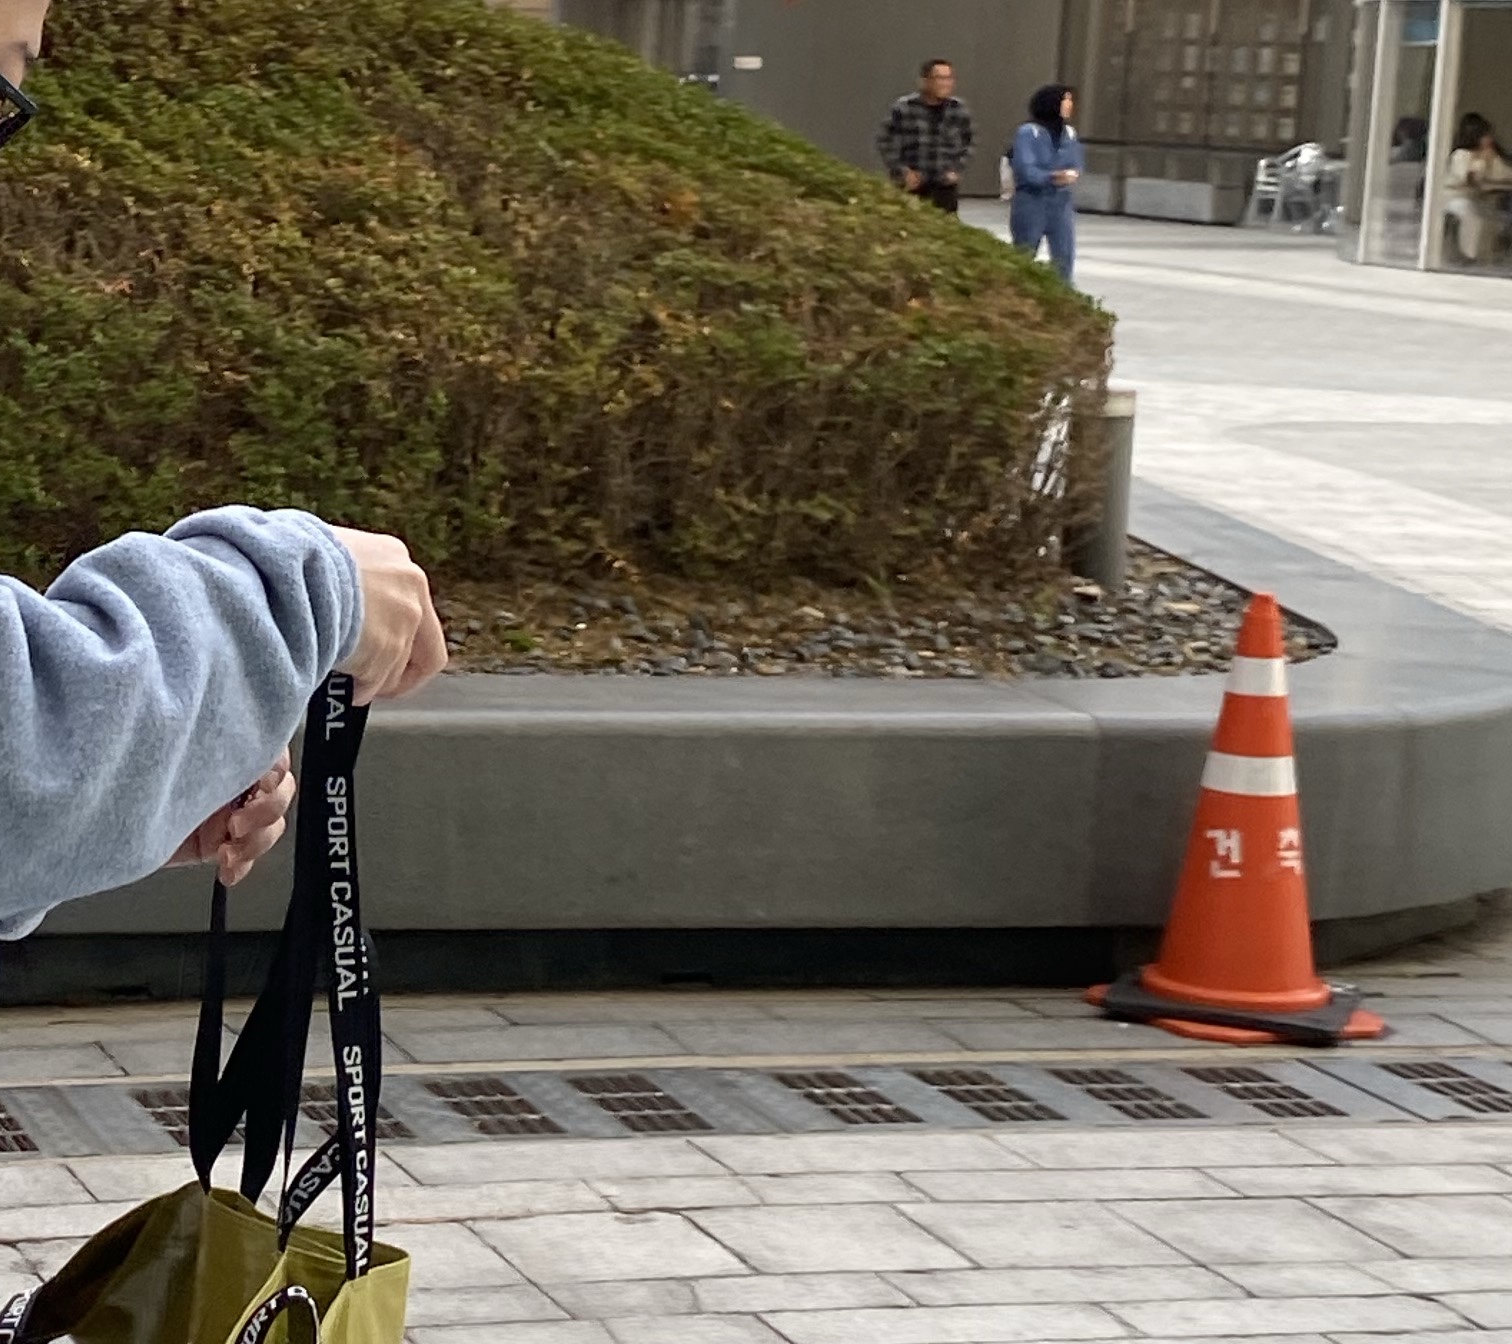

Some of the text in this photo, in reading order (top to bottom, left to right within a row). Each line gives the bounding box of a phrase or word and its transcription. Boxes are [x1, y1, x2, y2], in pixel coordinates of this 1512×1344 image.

[326, 776, 359, 1012] SPORT CASUAL
[343, 1045, 369, 1278] SPORT CASUAL
